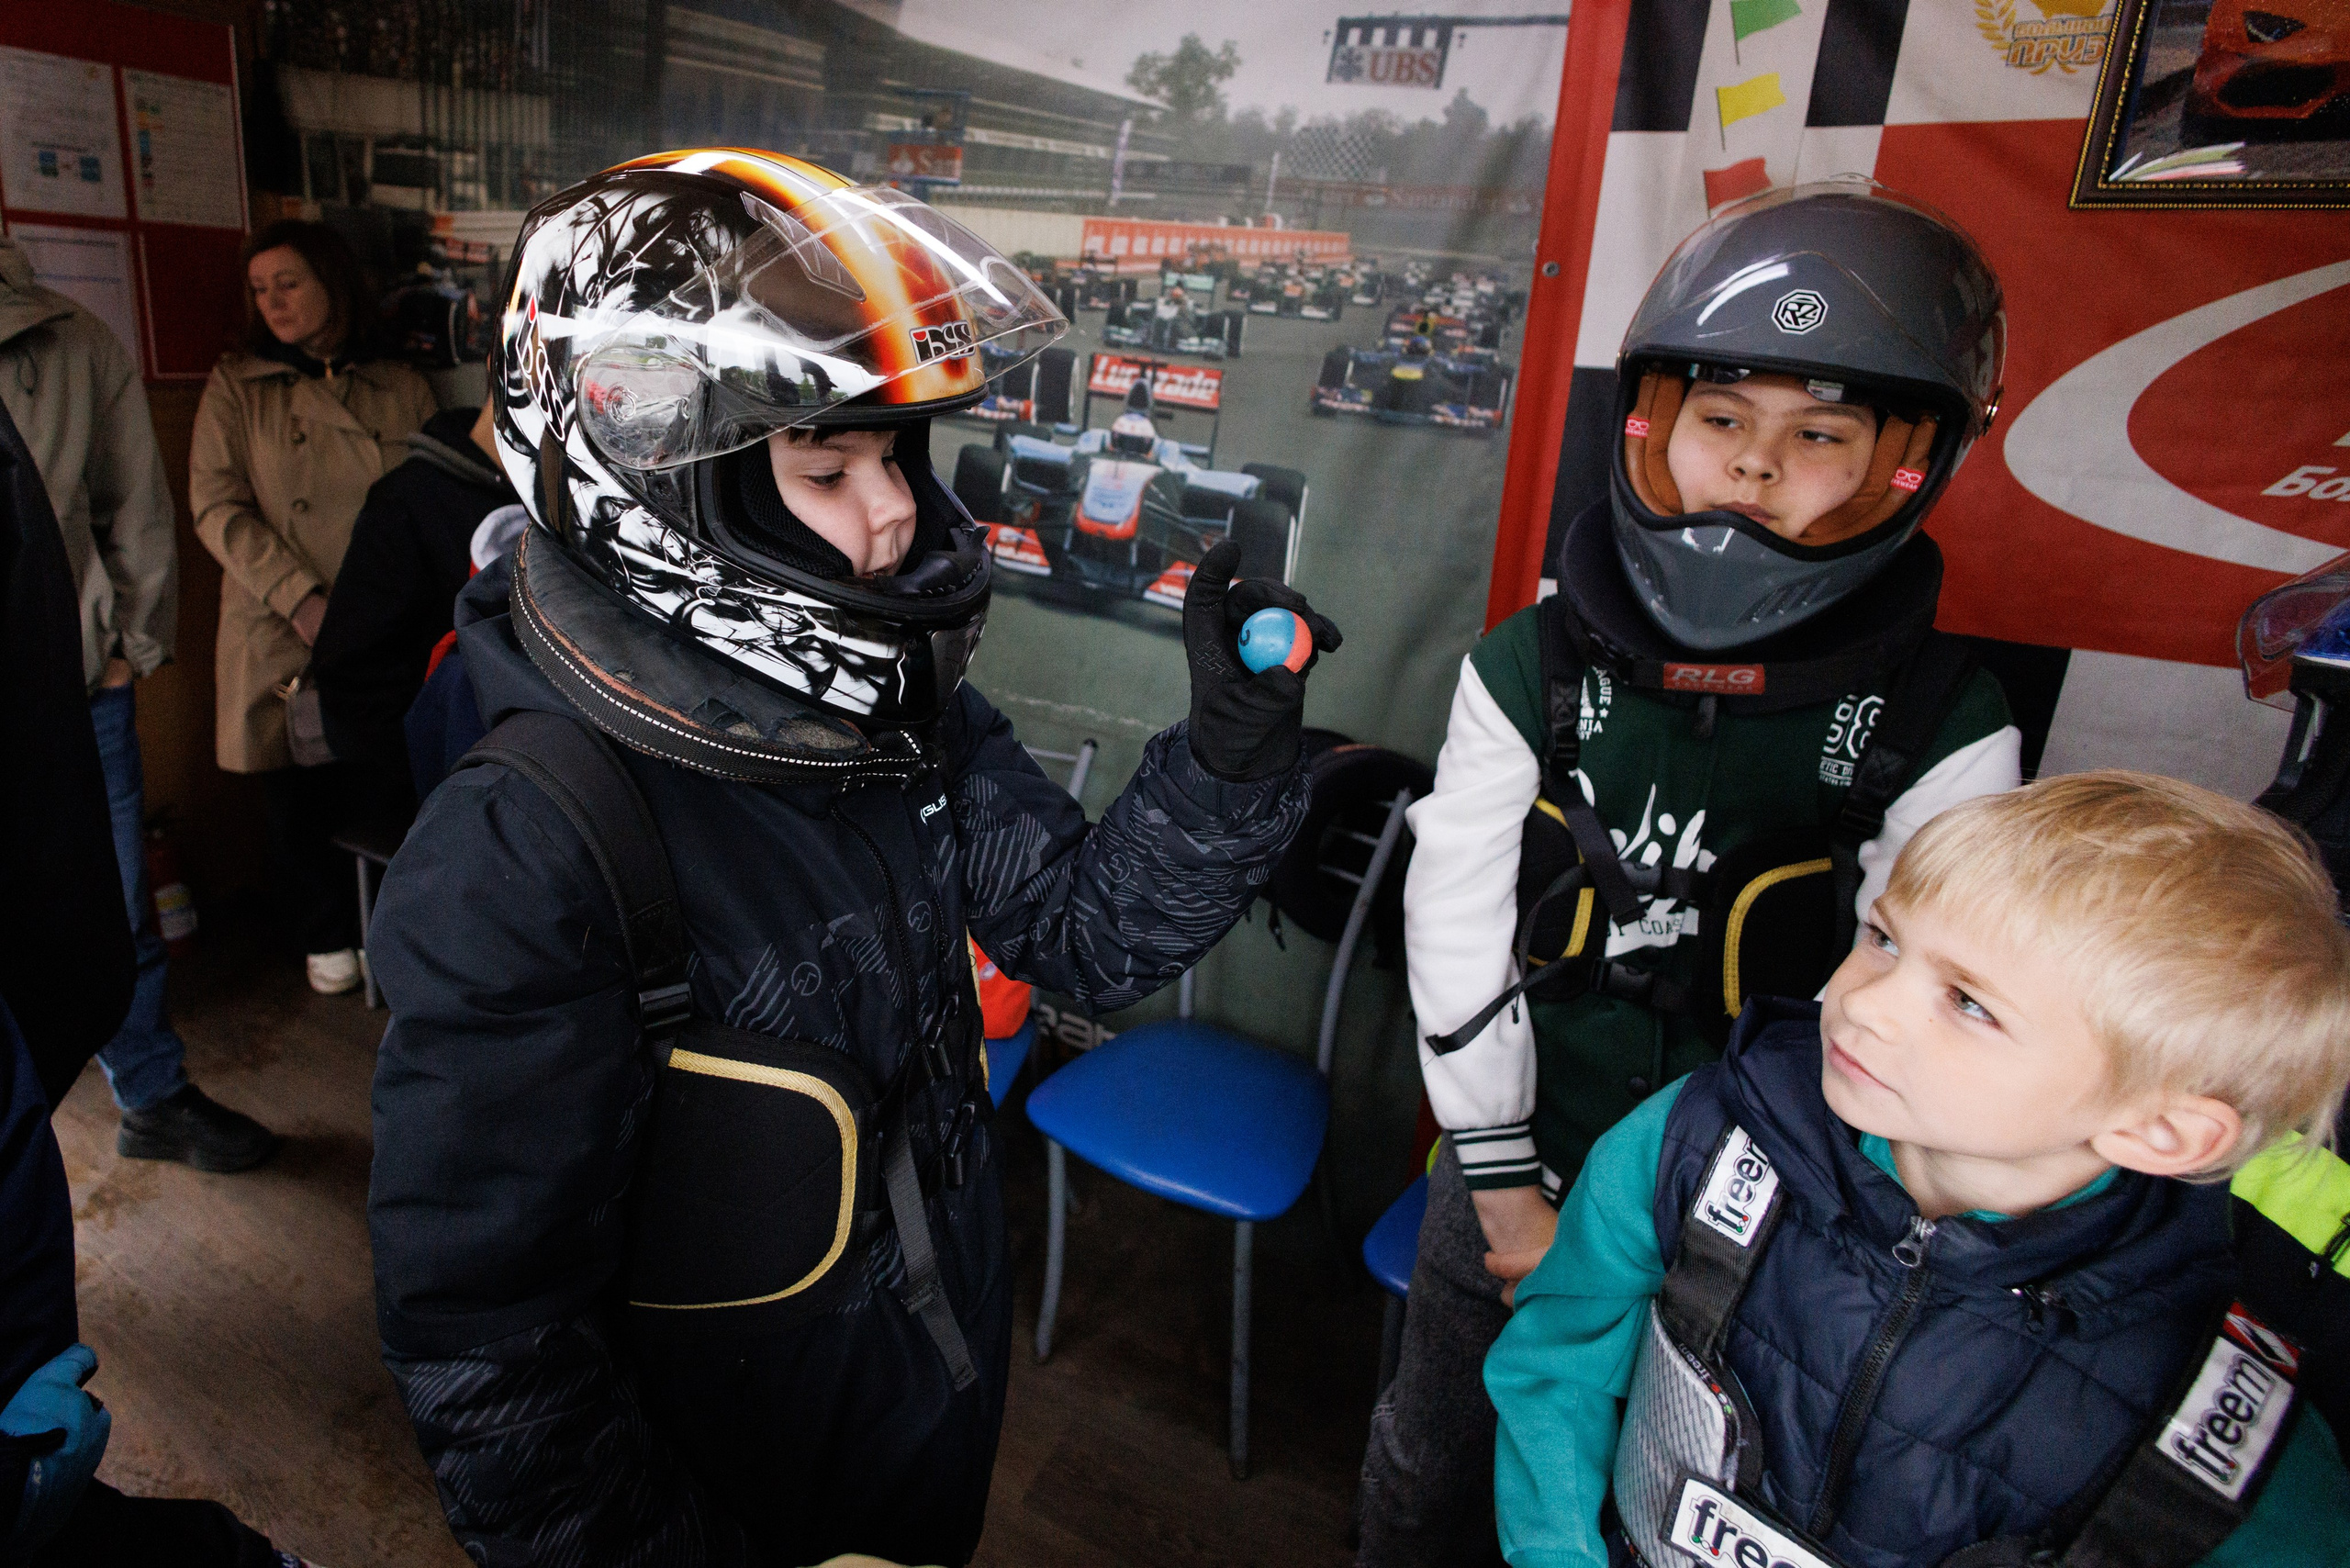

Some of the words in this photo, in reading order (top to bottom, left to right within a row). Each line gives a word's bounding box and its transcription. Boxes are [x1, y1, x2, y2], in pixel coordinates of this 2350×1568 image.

[1370, 50, 1435, 84] UBS
[1091, 355, 1220, 402] Luczade
[1592, 666, 1612, 706] AGUE
[1673, 668, 1756, 685] RLG
[2176, 1356, 2277, 1482] freem
[1693, 1498, 1799, 1568] fre
